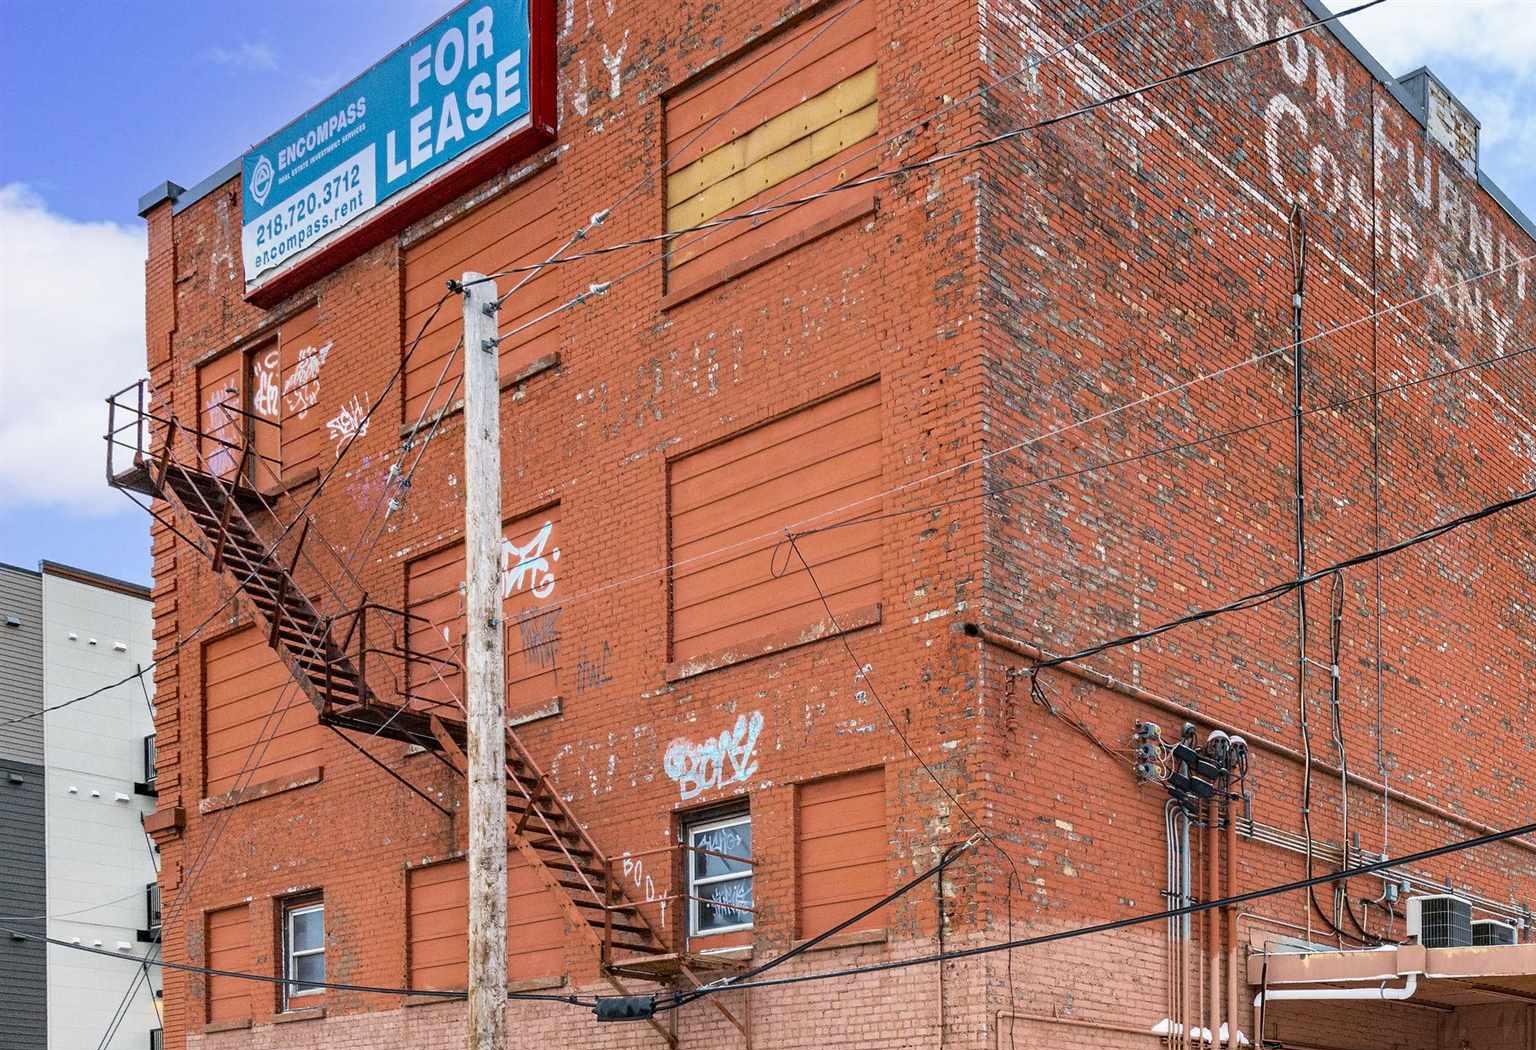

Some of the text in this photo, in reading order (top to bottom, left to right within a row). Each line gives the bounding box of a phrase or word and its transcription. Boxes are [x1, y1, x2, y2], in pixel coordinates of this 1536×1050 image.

[409, 5, 494, 108] FOR
[277, 96, 367, 171] ENCOMPASS
[386, 48, 521, 184] LEASE
[255, 190, 364, 268] encompass.rent
[256, 163, 360, 247] 218.720.3712
